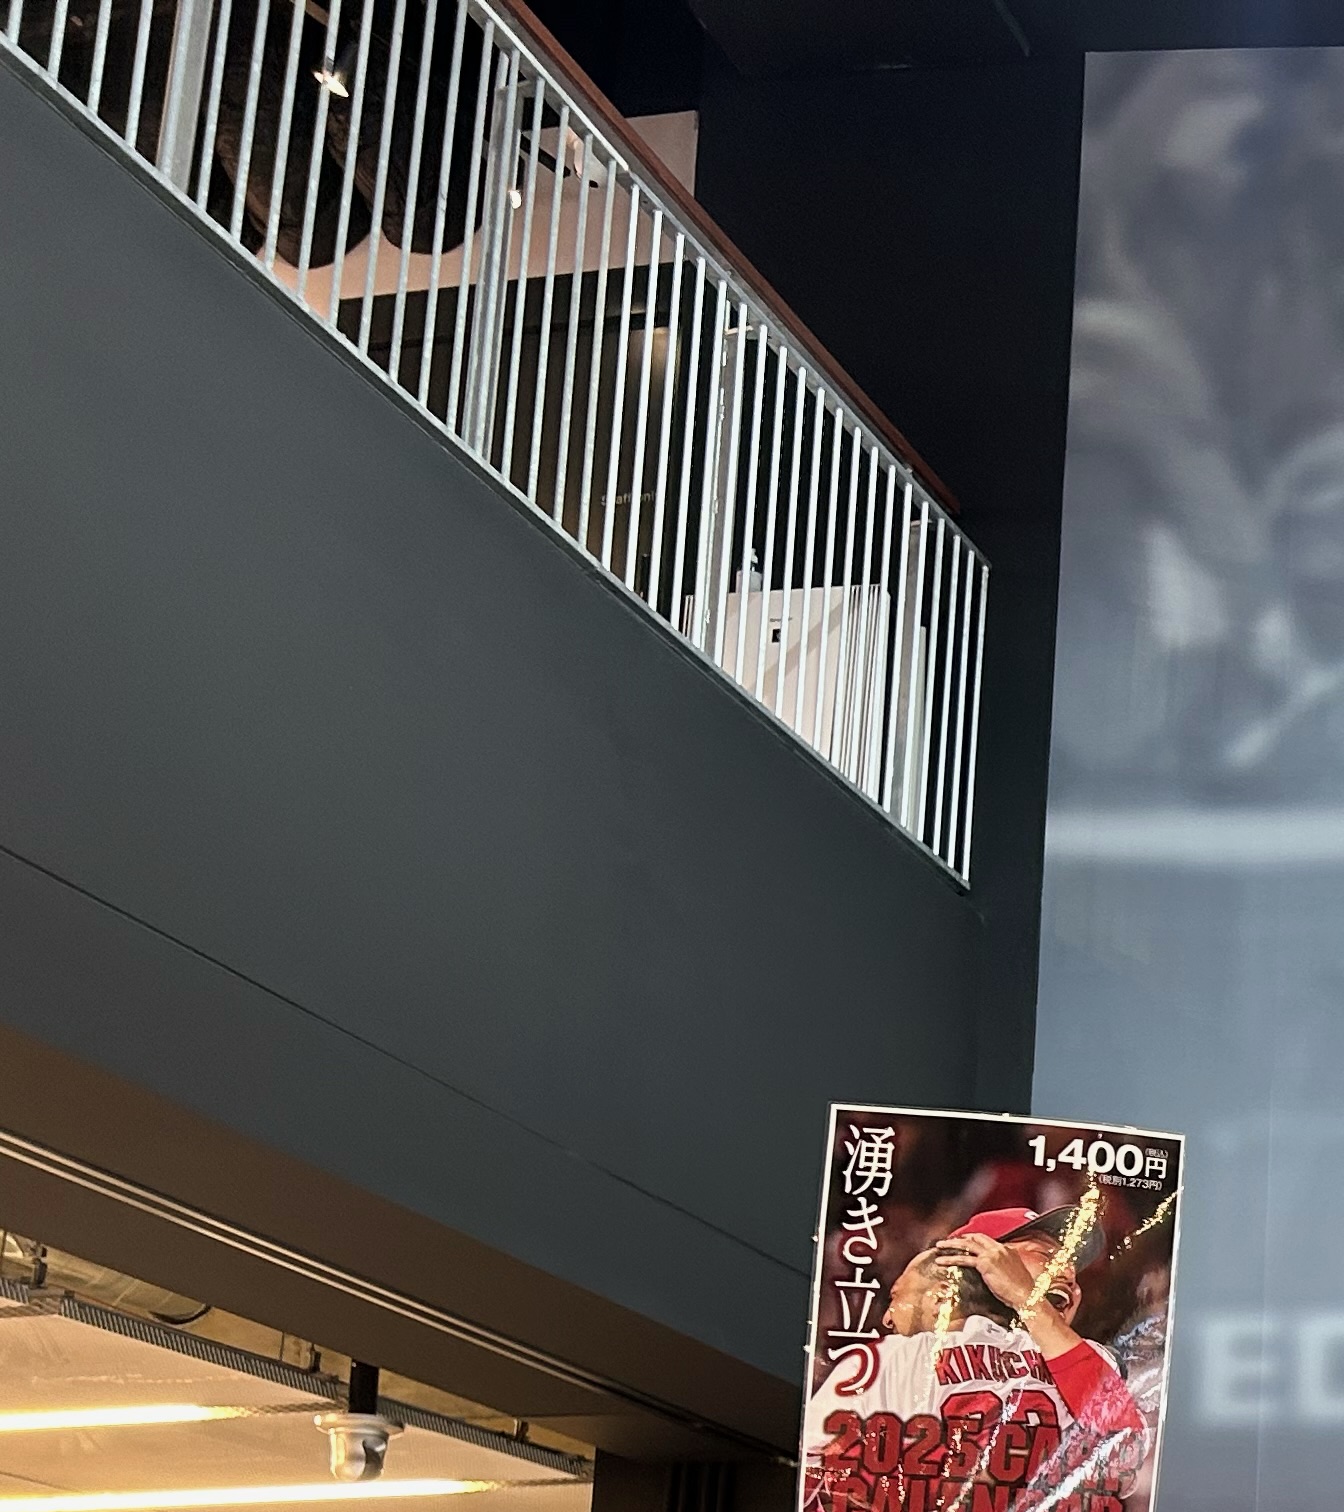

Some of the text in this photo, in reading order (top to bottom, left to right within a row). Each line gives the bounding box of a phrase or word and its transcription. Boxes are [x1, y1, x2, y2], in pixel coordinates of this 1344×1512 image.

[1028, 1135, 1168, 1180] 1,400円
[827, 1125, 896, 1395] 湧き立つ
[824, 1409, 976, 1477] 2025
